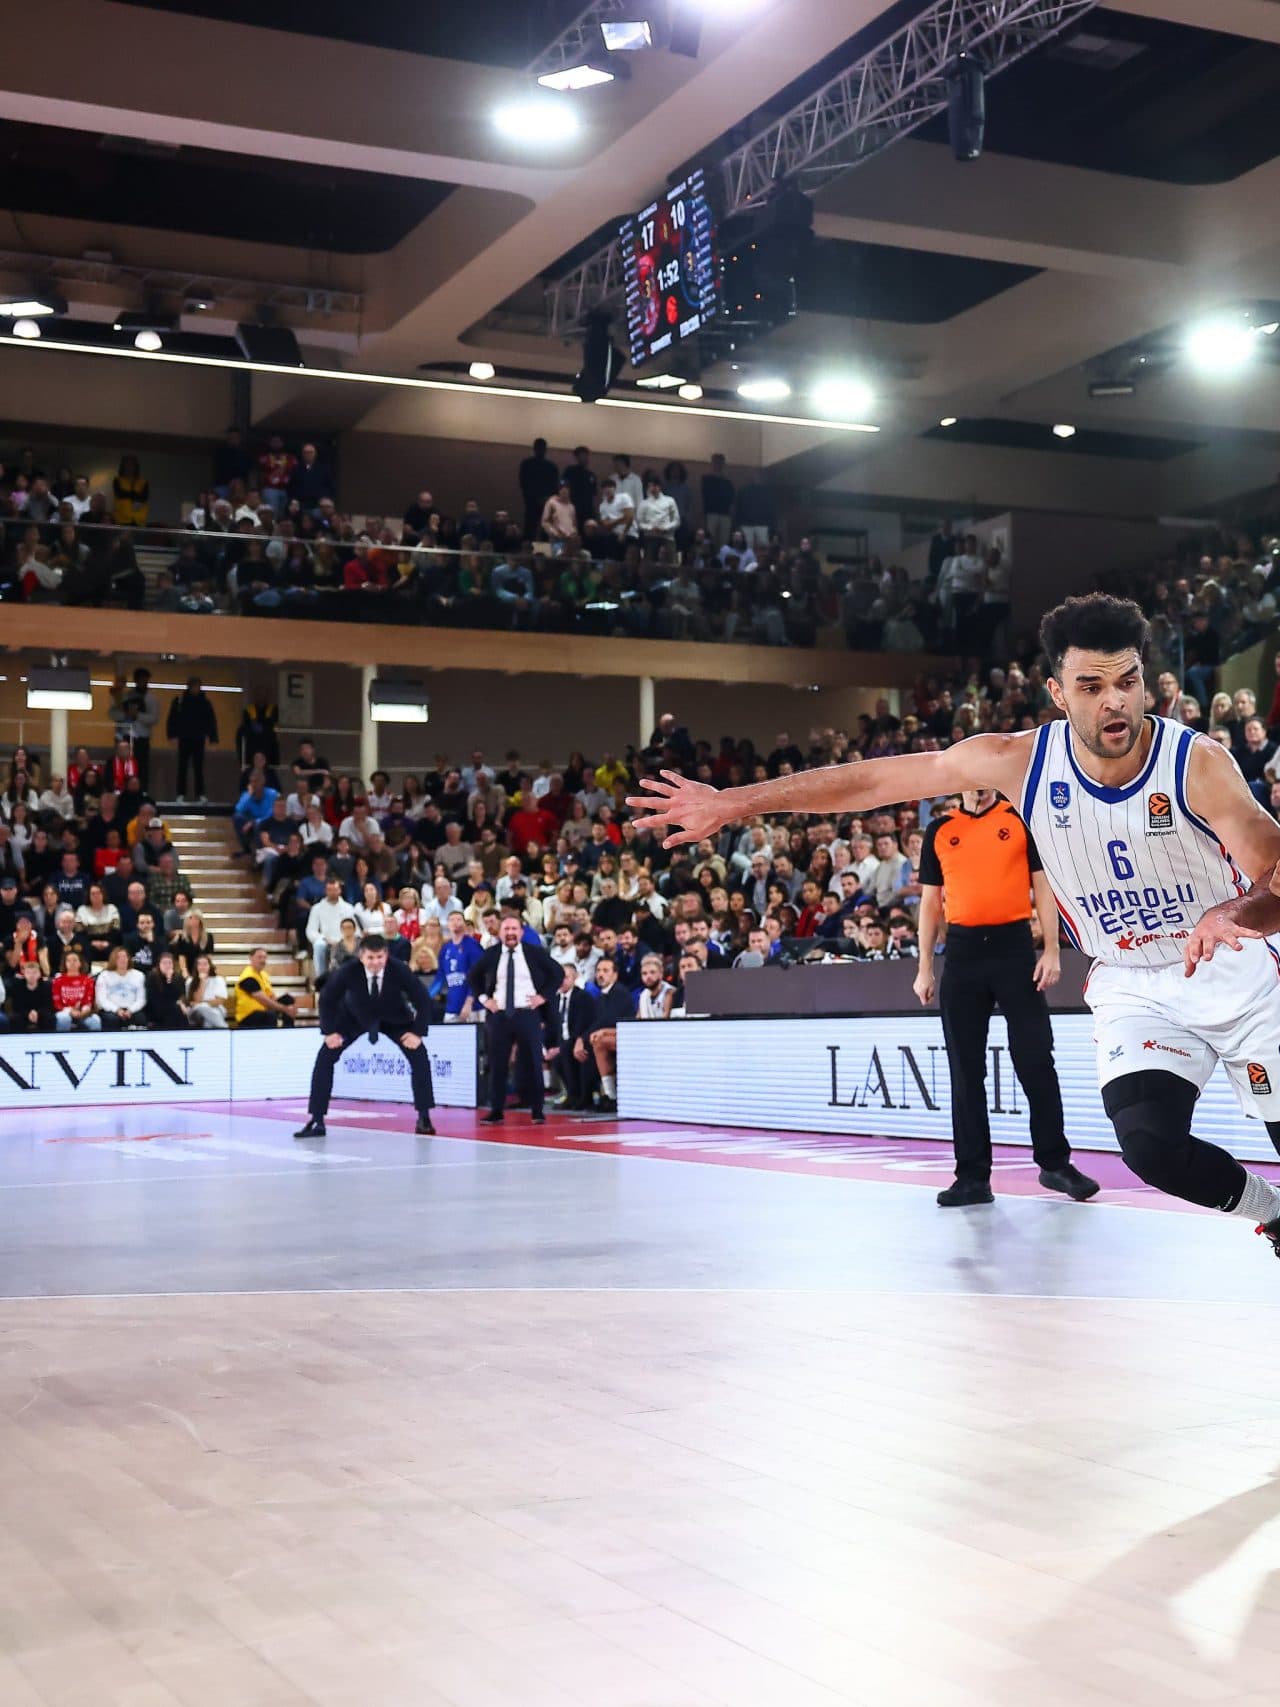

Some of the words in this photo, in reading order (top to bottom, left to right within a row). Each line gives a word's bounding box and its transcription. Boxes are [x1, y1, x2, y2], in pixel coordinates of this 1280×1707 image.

[670, 200, 686, 230] 10
[641, 220, 655, 250] 17
[287, 672, 305, 699] E
[1107, 840, 1135, 881] 6
[1098, 904, 1185, 935] EFES
